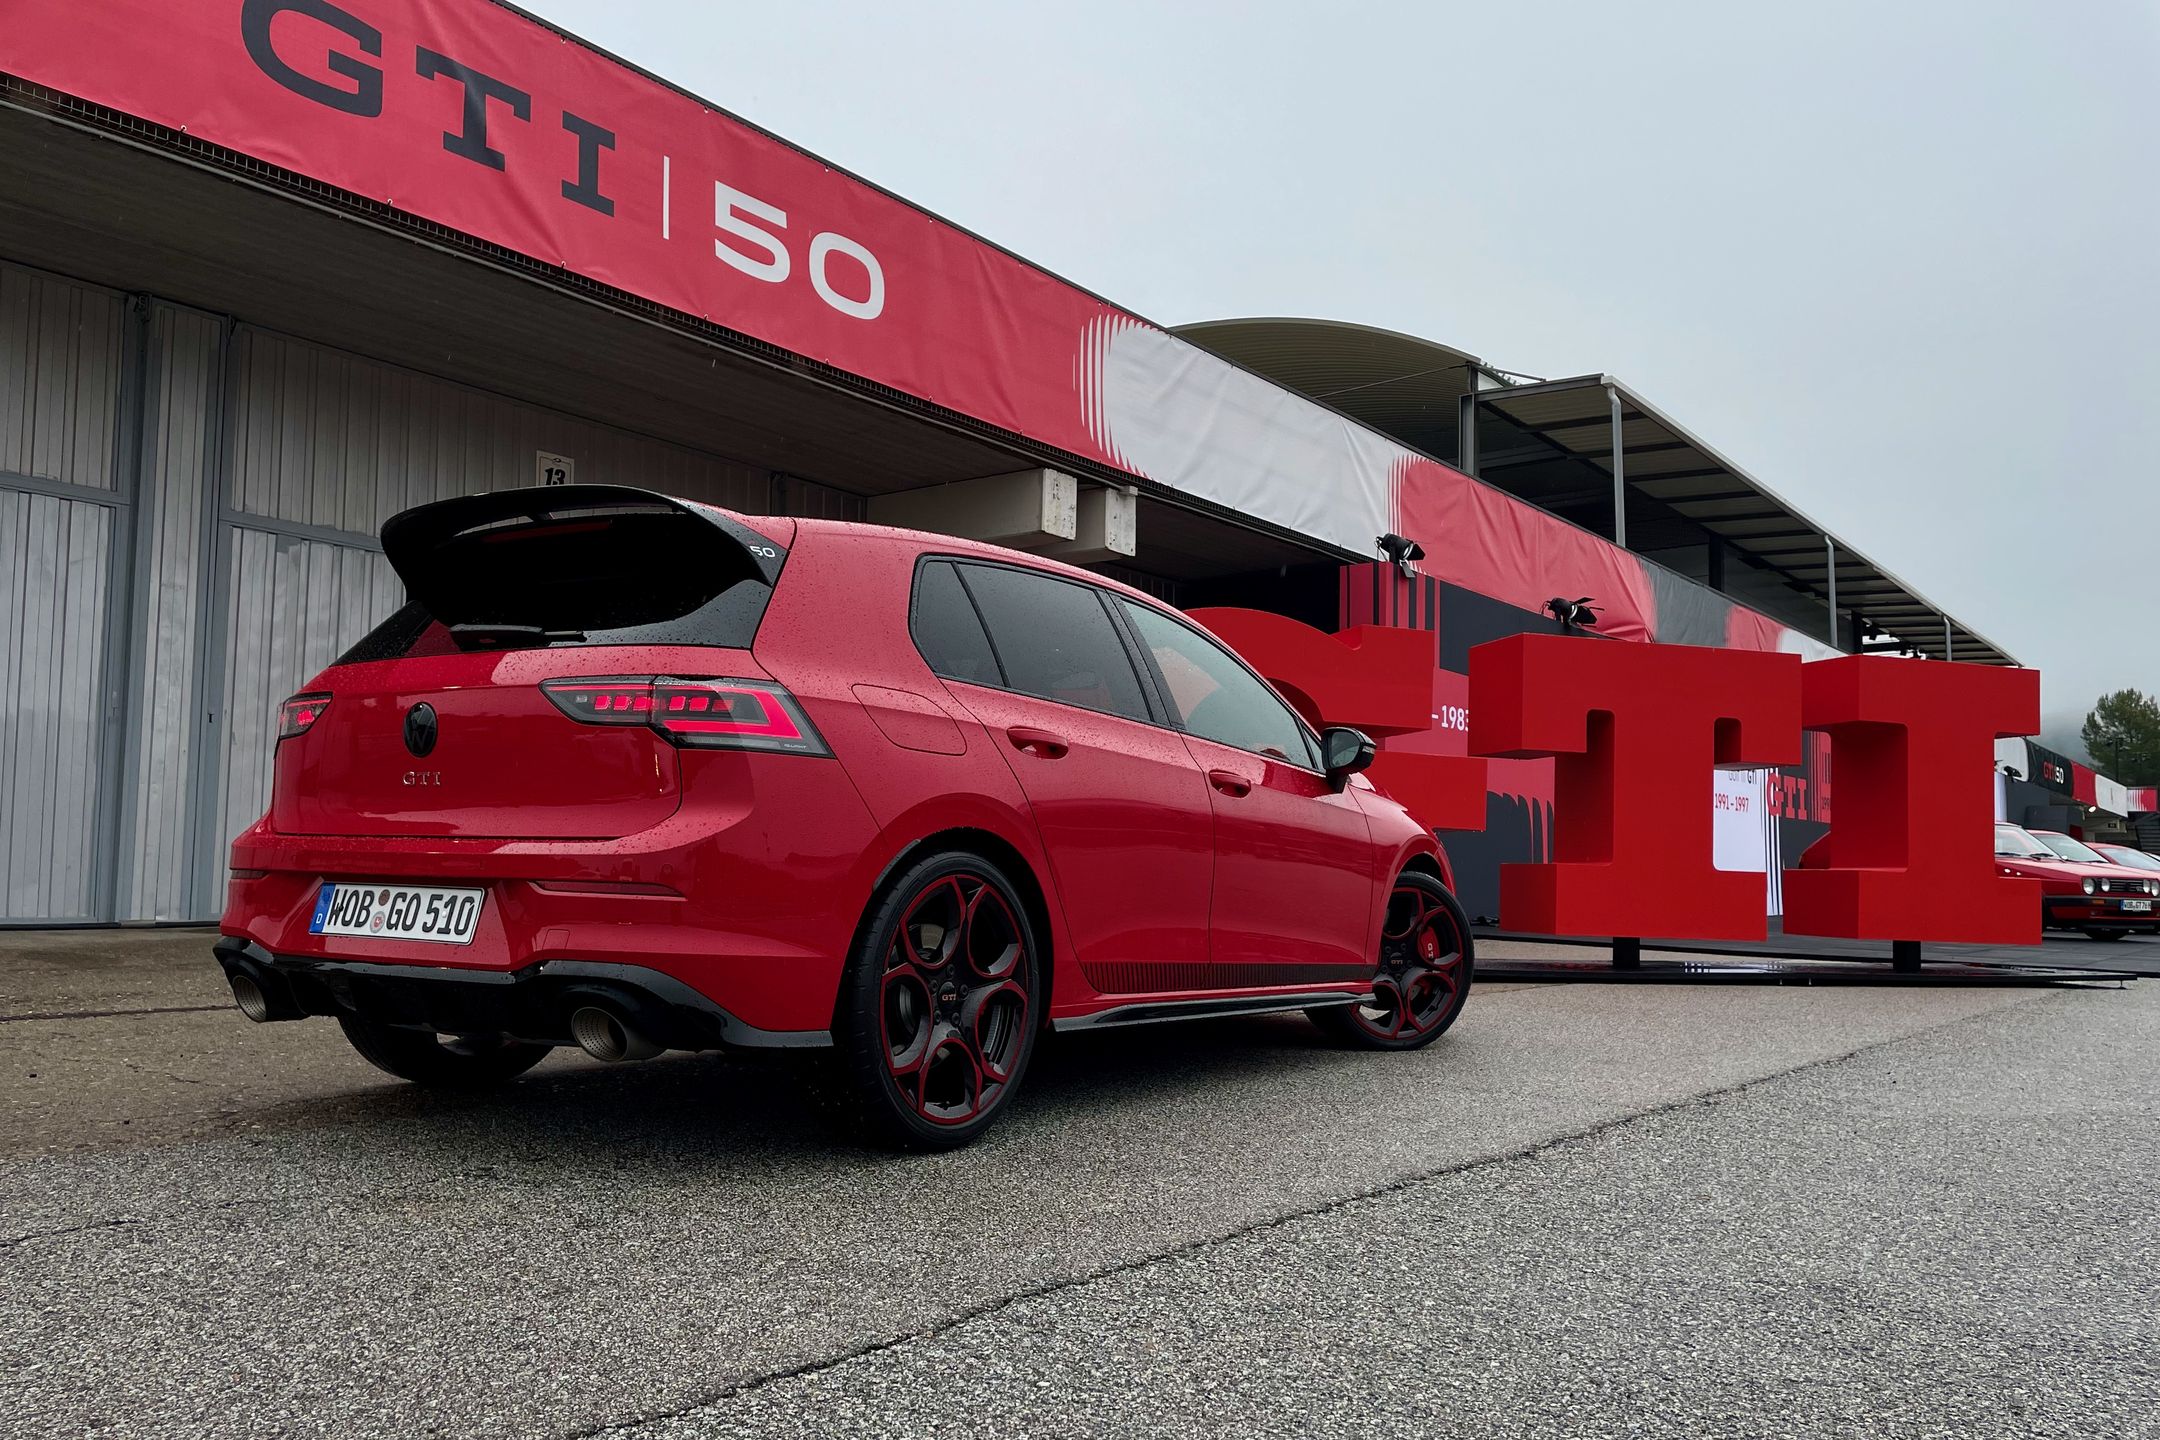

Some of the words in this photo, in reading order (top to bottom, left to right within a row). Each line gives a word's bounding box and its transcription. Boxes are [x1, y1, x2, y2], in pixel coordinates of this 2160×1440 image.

[241, 0, 615, 217] GTI
[714, 179, 885, 320] 50
[544, 467, 566, 486] 13
[749, 545, 776, 558] 50
[403, 771, 441, 786] GTI
[1766, 772, 1808, 820] GTI
[316, 913, 323, 924] D
[327, 888, 375, 928] WOB
[386, 891, 422, 931] GO
[421, 894, 475, 936] 510
[1427, 942, 1435, 959] GT
